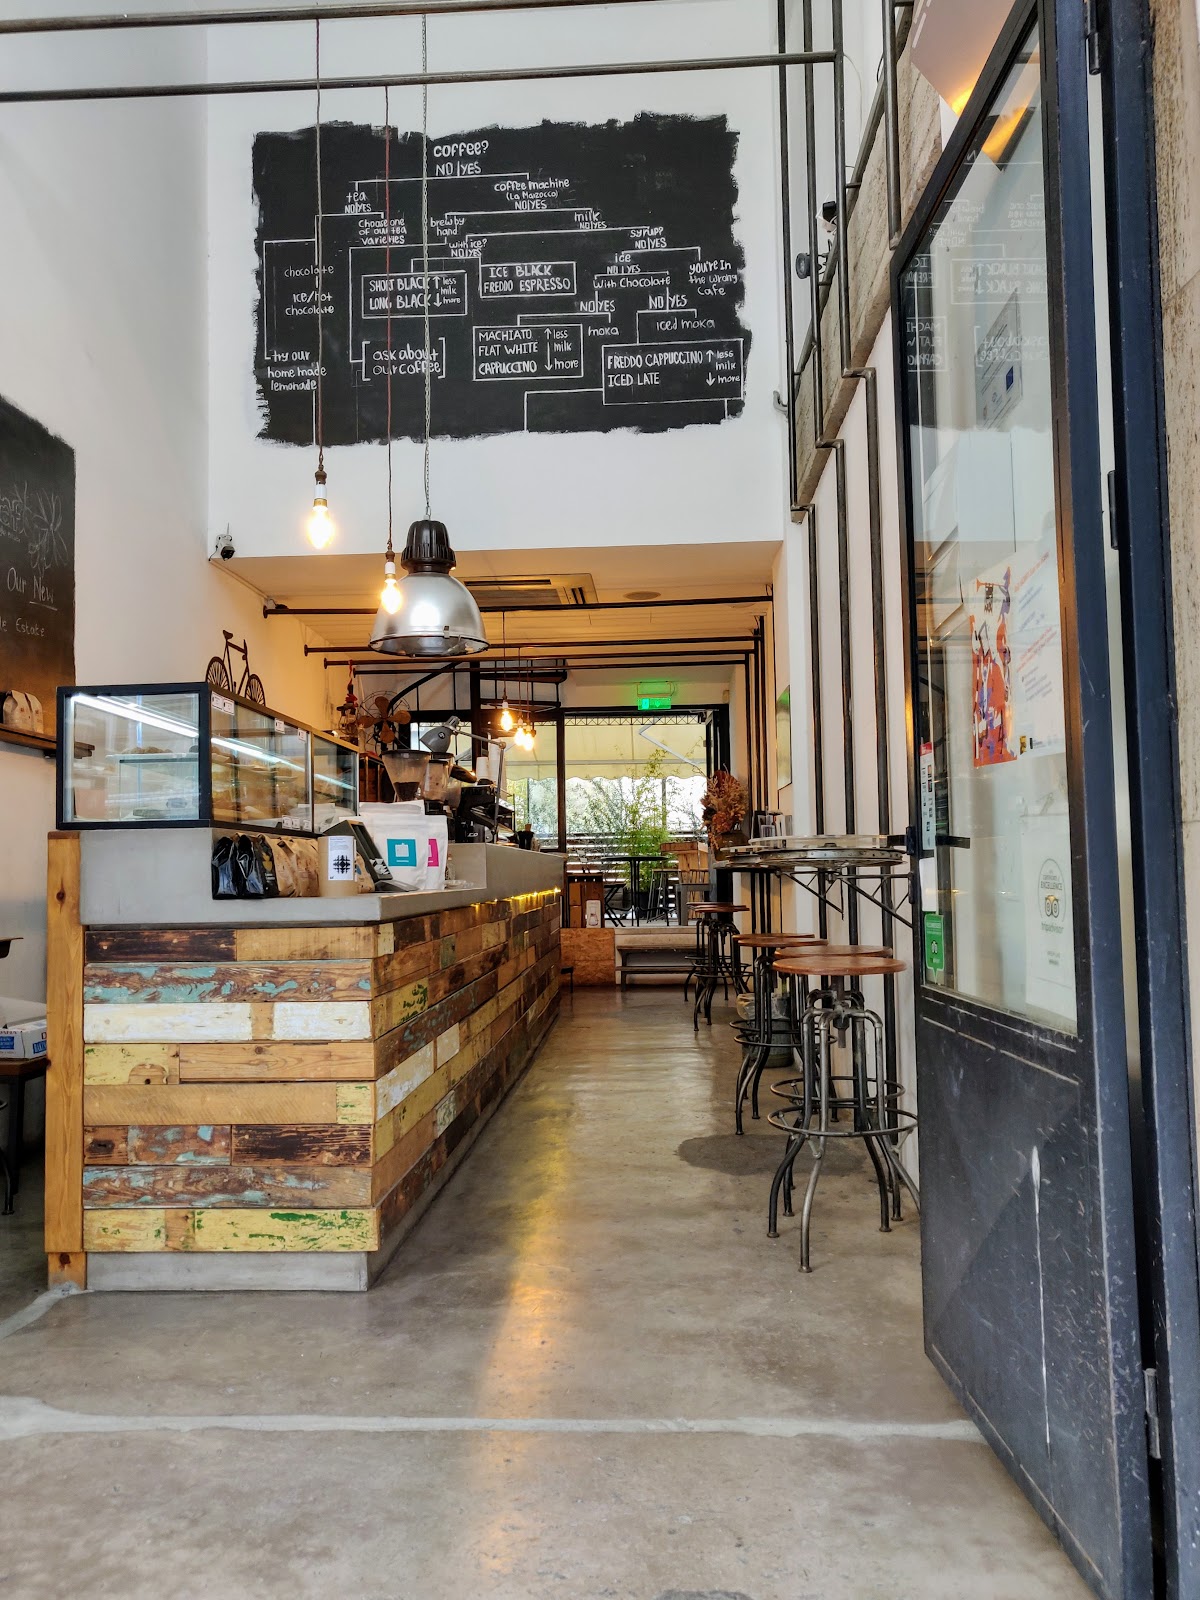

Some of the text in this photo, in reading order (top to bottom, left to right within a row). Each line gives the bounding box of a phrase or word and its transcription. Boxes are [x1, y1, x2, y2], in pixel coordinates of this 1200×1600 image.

[433, 140, 489, 158] coffee?
[494, 178, 570, 192] coffee machine
[346, 190, 367, 202] tea
[390, 218, 405, 227] one
[430, 216, 465, 228] brew by
[574, 211, 600, 223] milk
[359, 227, 371, 236] of
[391, 226, 407, 235] tea
[437, 226, 458, 236] hand
[630, 226, 664, 239] syrup?
[361, 235, 405, 246] varieties
[449, 237, 488, 249] with ice?
[615, 253, 631, 263] ice
[284, 264, 335, 278] chocolate
[489, 265, 552, 278] ICE BLACK
[397, 276, 431, 291] BLACK
[442, 276, 457, 285] less
[483, 277, 571, 293] FREDDO ESPRESSO
[689, 274, 707, 284] the
[440, 285, 457, 295] milk
[369, 293, 432, 310] LONG BLACK
[443, 296, 461, 304] more
[285, 304, 335, 316] chocolate
[681, 317, 715, 330] moka
[479, 329, 568, 342] MACHIATO less
[588, 325, 619, 337] moka
[373, 343, 439, 362] ask about
[478, 340, 572, 357] FLAT WHITE milk
[716, 350, 734, 359] less
[271, 349, 310, 362] try our
[607, 350, 703, 369] FREDDO CAPPUCCINO
[267, 361, 328, 378] home made
[373, 364, 398, 375] our
[478, 358, 579, 375] CAPPUCCINO more
[715, 361, 736, 371] milk
[271, 378, 318, 391] lemonade
[607, 372, 660, 387] ICED LATE
[717, 375, 740, 384] more
[7, 567, 27, 594] Our
[16, 617, 45, 638] Estate
